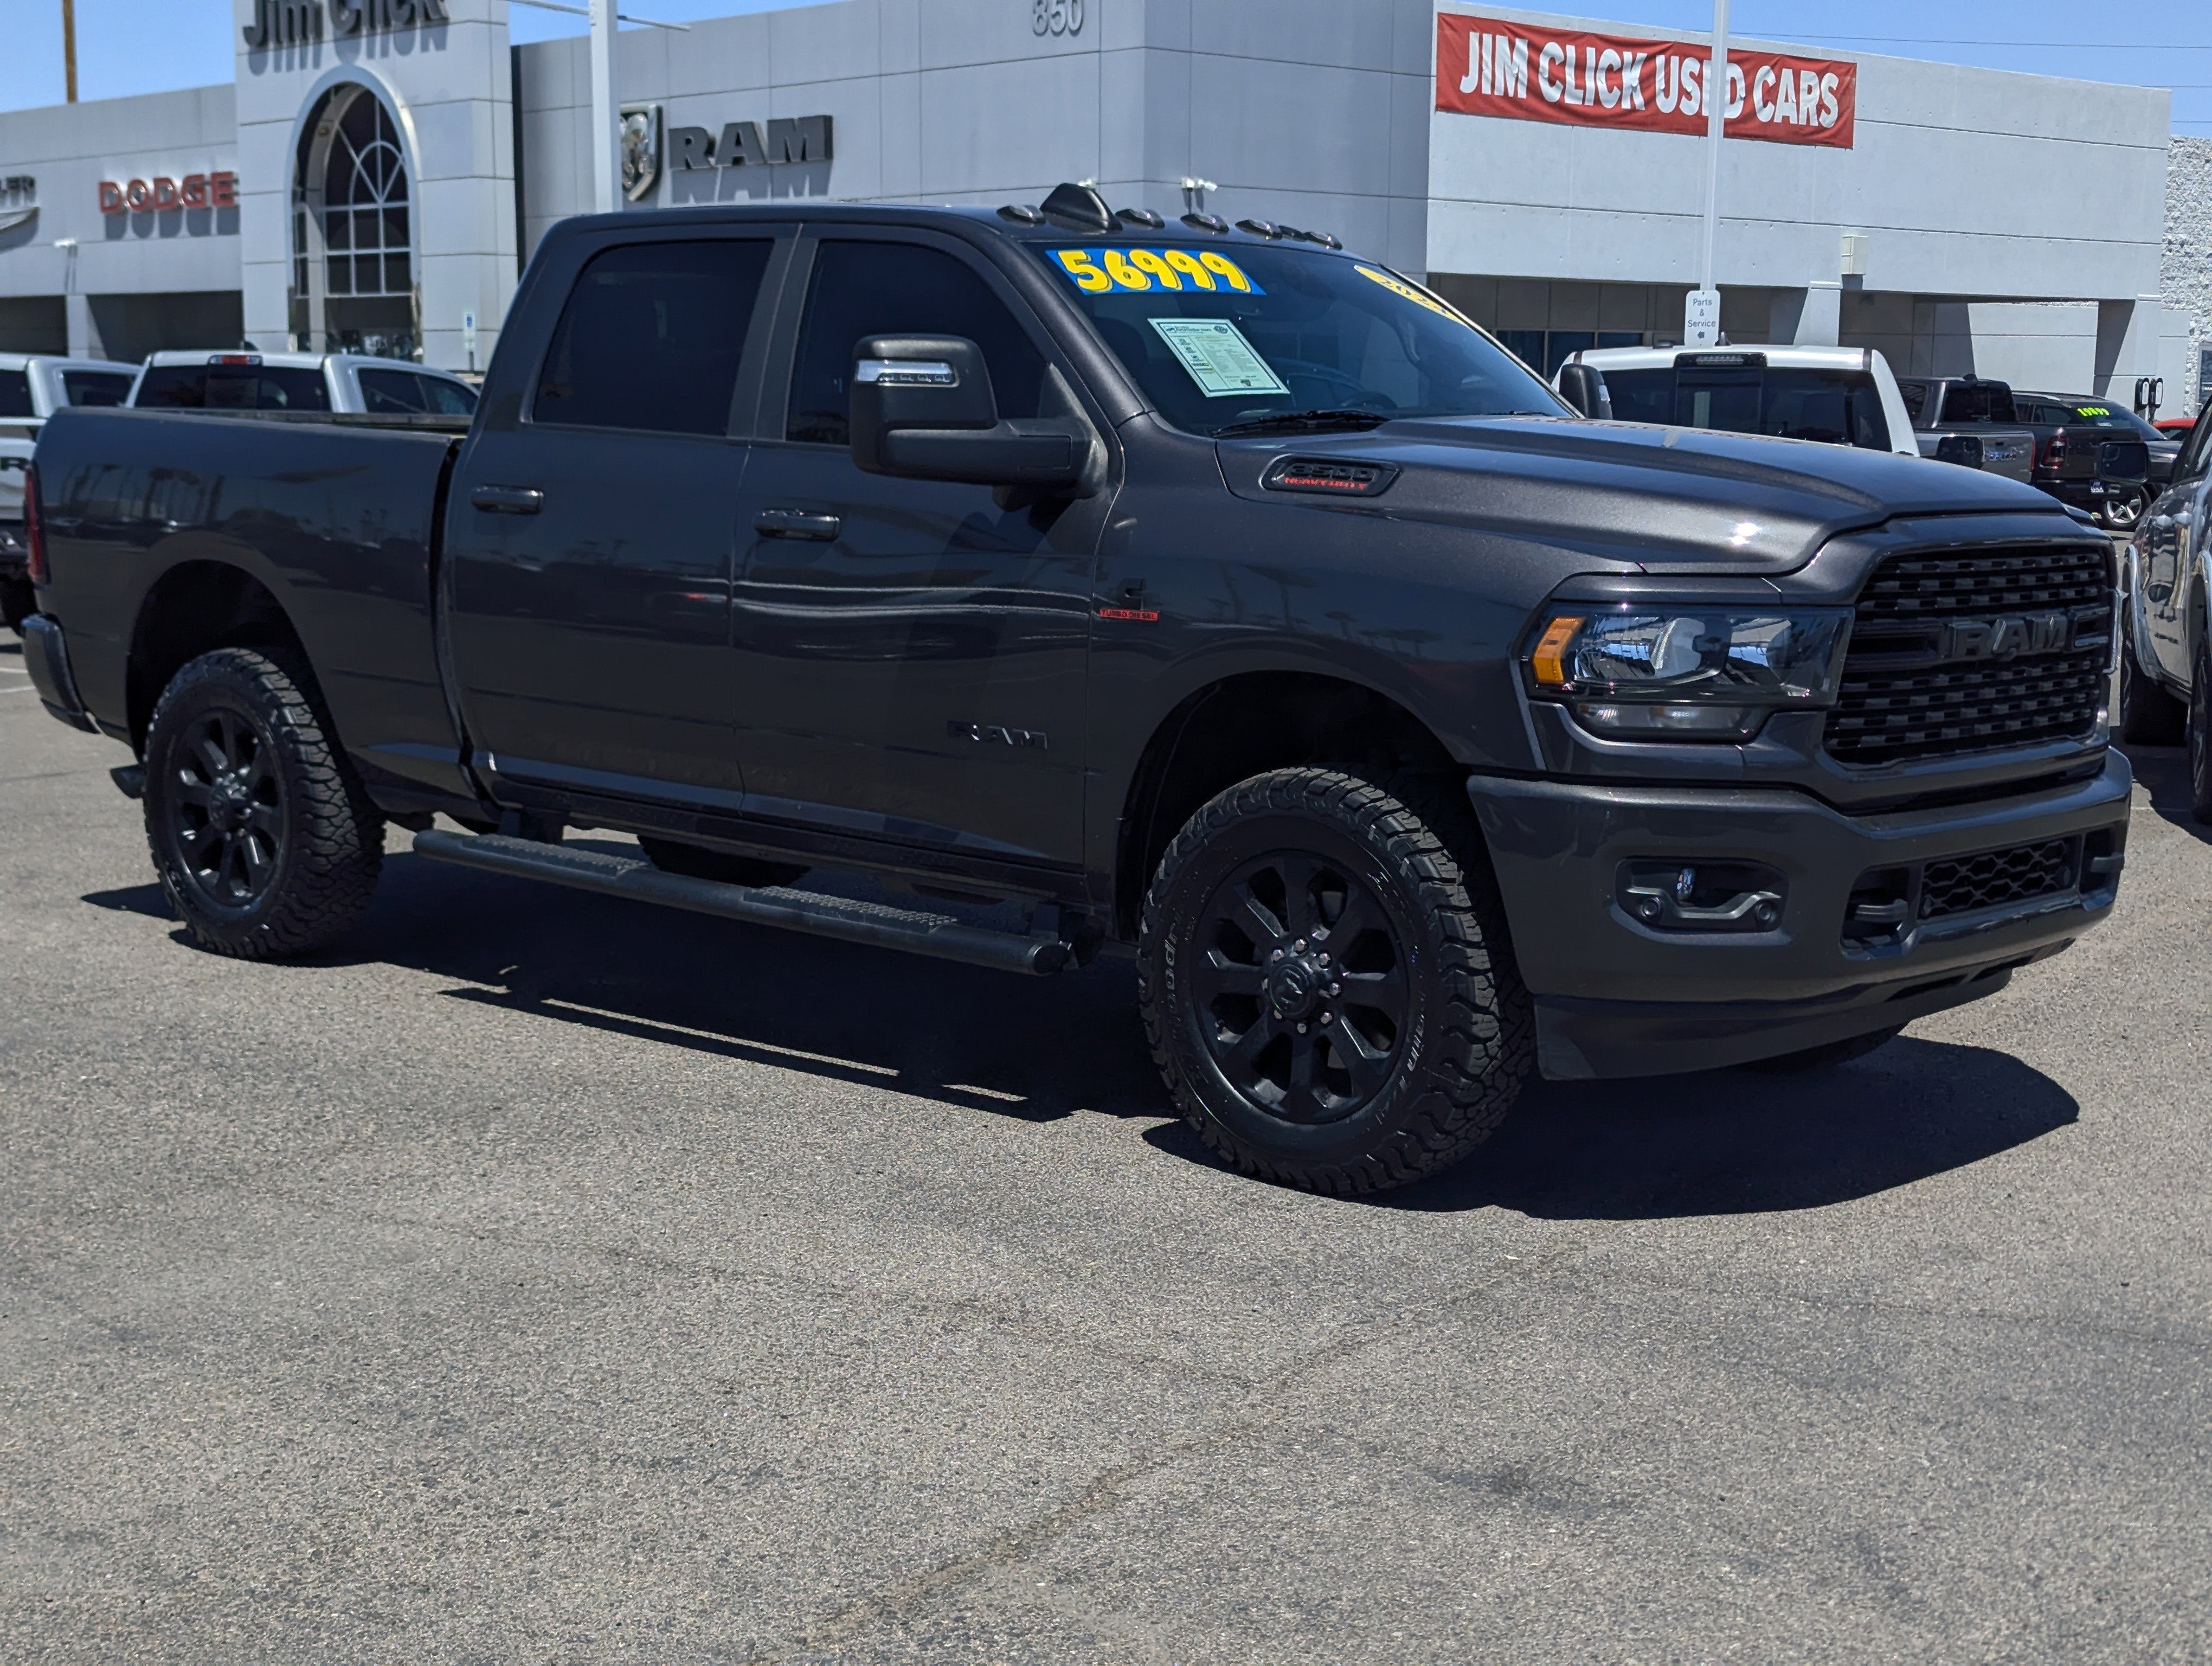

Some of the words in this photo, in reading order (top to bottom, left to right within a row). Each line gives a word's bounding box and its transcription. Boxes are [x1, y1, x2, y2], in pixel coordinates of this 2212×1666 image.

[1032, 0, 1084, 36] 850
[1459, 31, 1529, 99] JIM
[1538, 41, 1648, 111] CLICK
[1753, 65, 1840, 129] CARS
[668, 114, 833, 169] RAM
[99, 171, 235, 214] DODGE
[1058, 249, 1251, 292] 56999
[1378, 275, 1447, 315] 2024
[1699, 309, 1705, 317] &
[1688, 319, 1716, 328] Service
[1949, 614, 2068, 659] RAM
